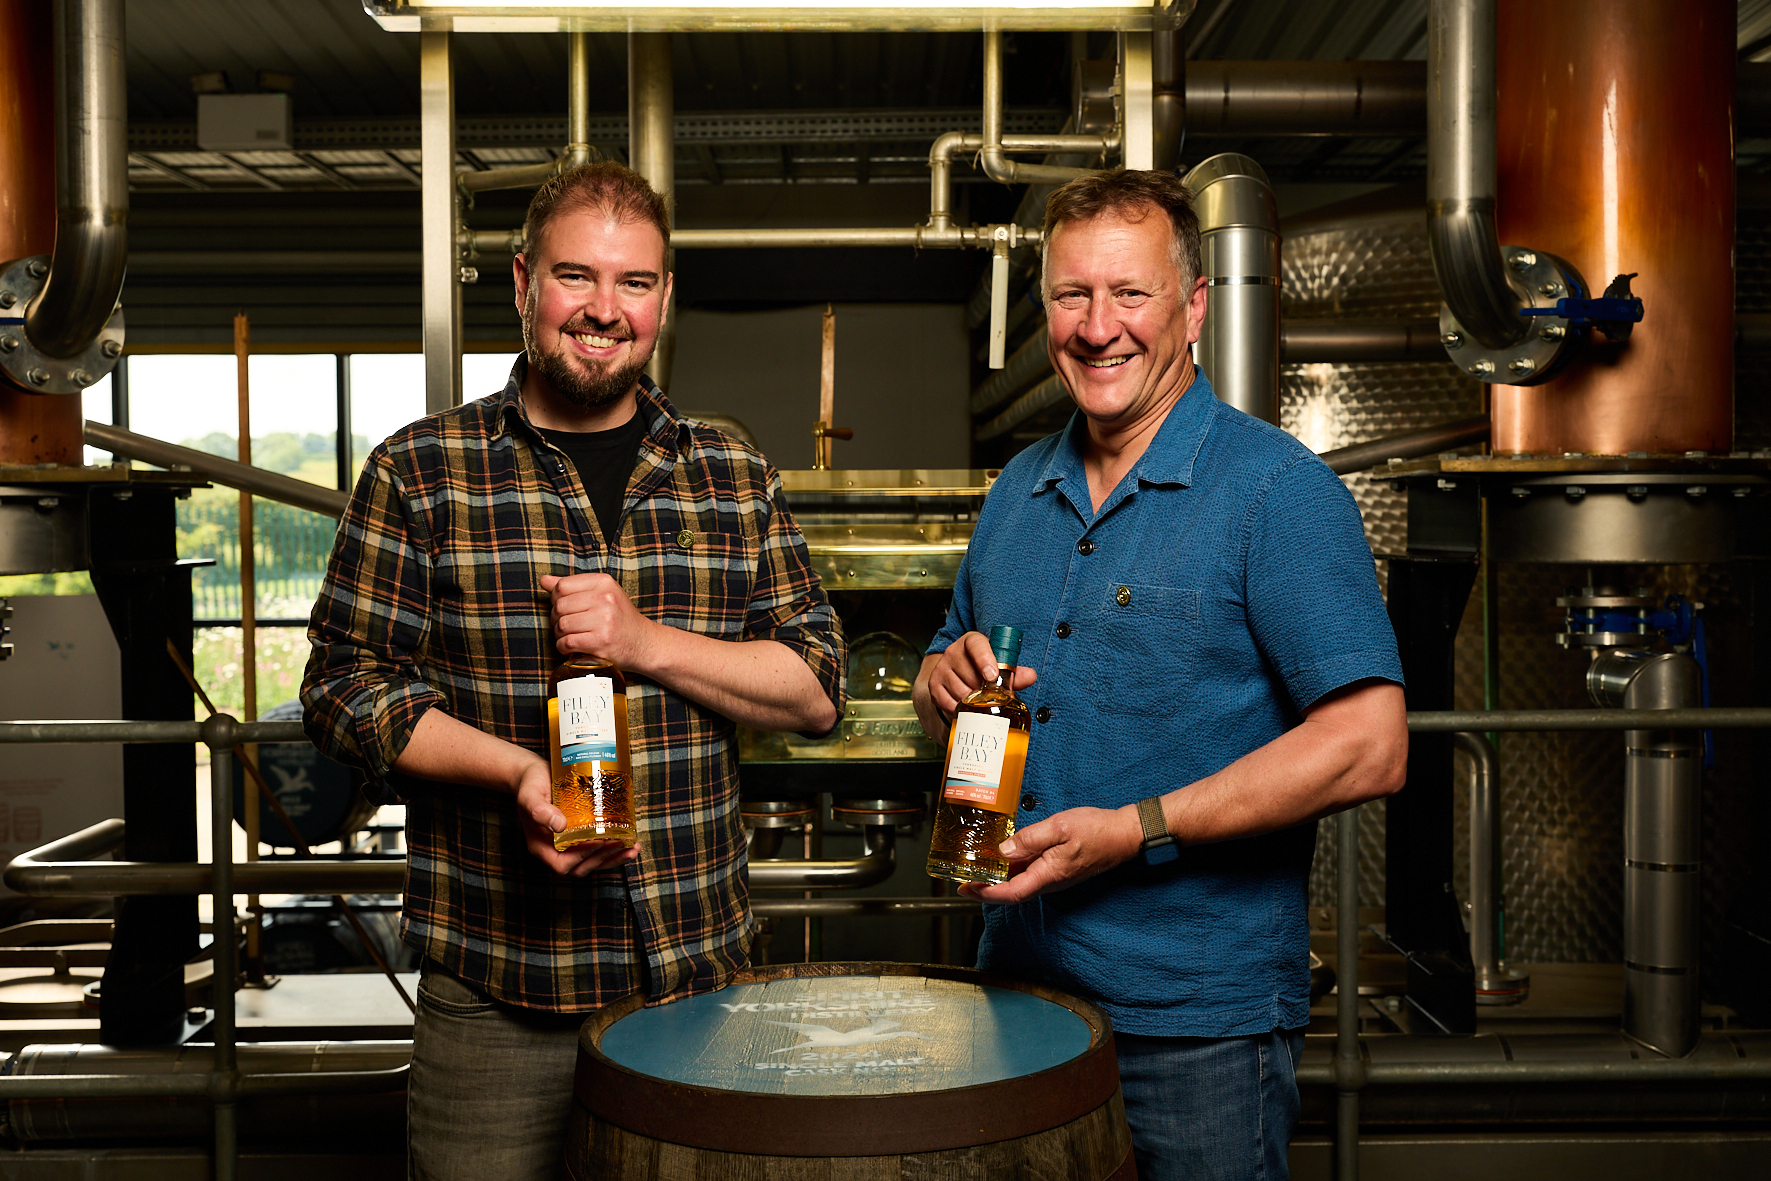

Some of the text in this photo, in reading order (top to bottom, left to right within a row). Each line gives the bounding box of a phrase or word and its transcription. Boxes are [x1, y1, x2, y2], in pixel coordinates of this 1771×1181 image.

[563, 696, 609, 712] FILEY
[571, 710, 603, 724] BAY
[872, 720, 924, 737] Forsyths
[957, 732, 1003, 749] FILEY
[961, 747, 993, 762] BAY
[794, 990, 906, 1001] SPIRIT
[719, 999, 936, 1012] YORKSHIRE
[801, 1051, 881, 1060] 2024
[855, 1057, 924, 1067] MALT
[785, 1068, 845, 1076] CASK
